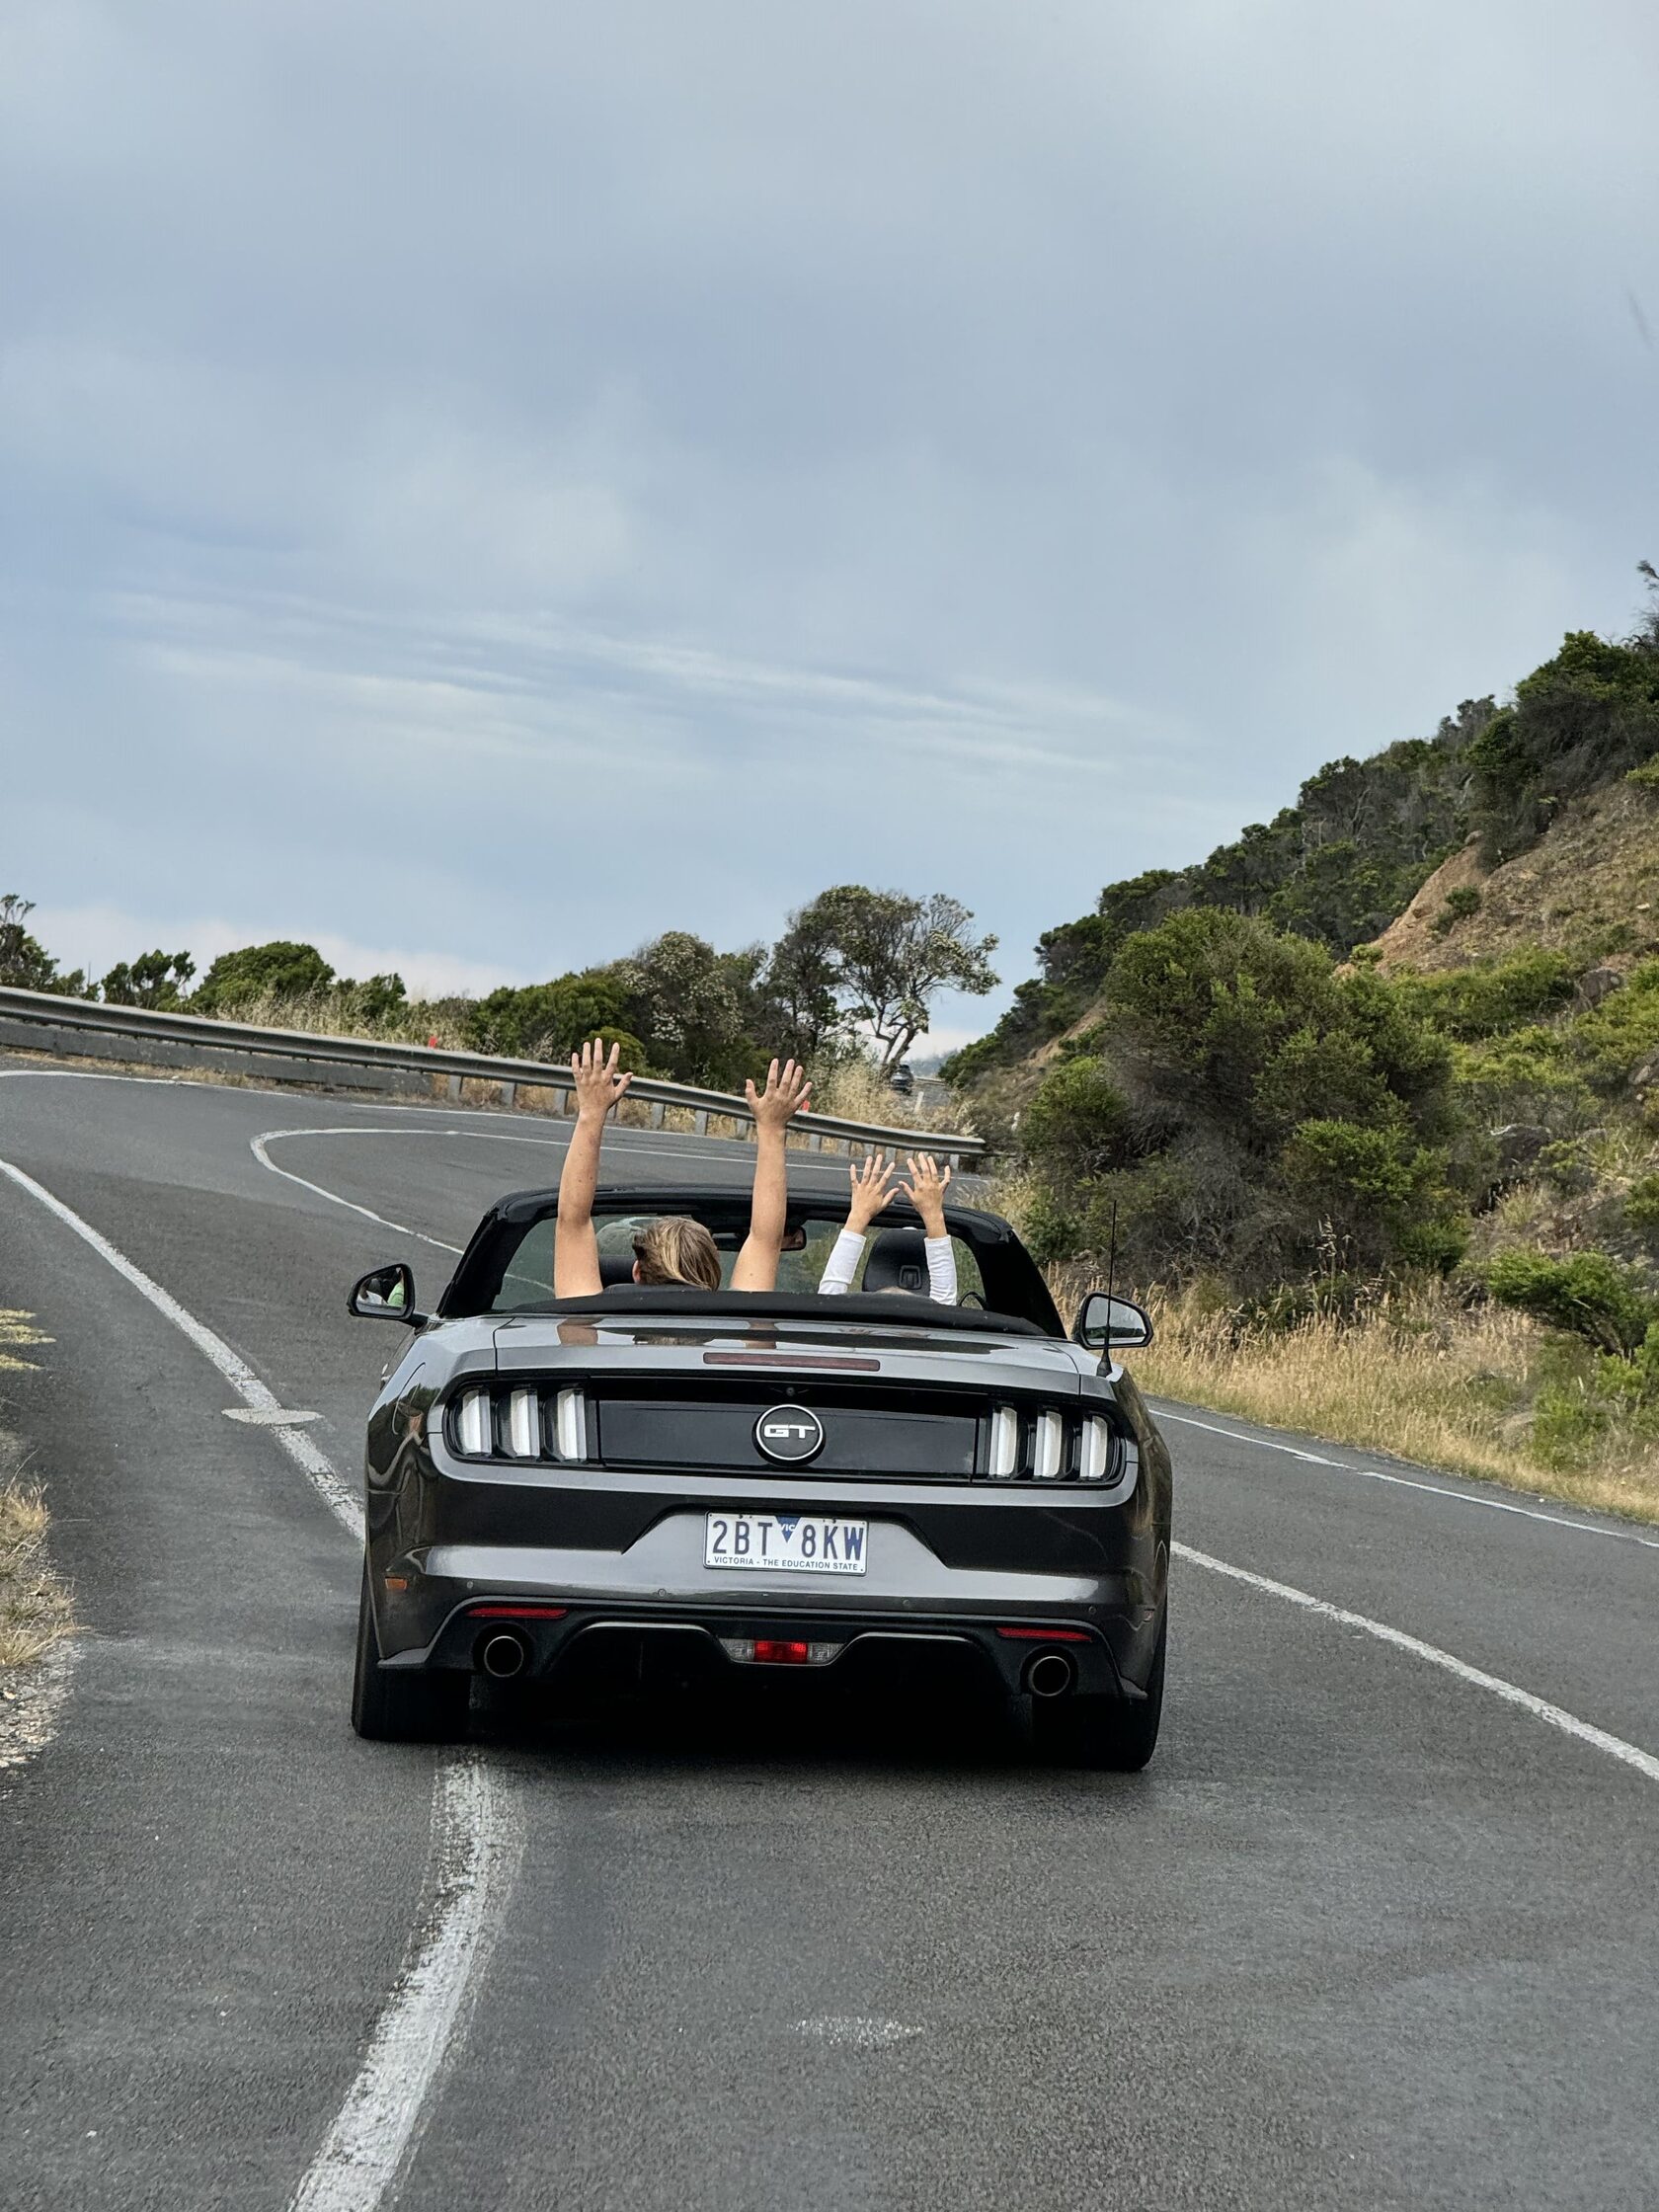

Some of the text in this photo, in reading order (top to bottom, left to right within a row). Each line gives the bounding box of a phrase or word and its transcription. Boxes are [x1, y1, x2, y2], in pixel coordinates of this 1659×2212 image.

[764, 1424, 816, 1439] GT
[712, 1520, 864, 1561] 2BT 8KW
[714, 1556, 754, 1565] VICTORIA
[762, 1558, 779, 1567] THE
[781, 1559, 830, 1569] EDUCATION
[832, 1561, 858, 1571] STATE
